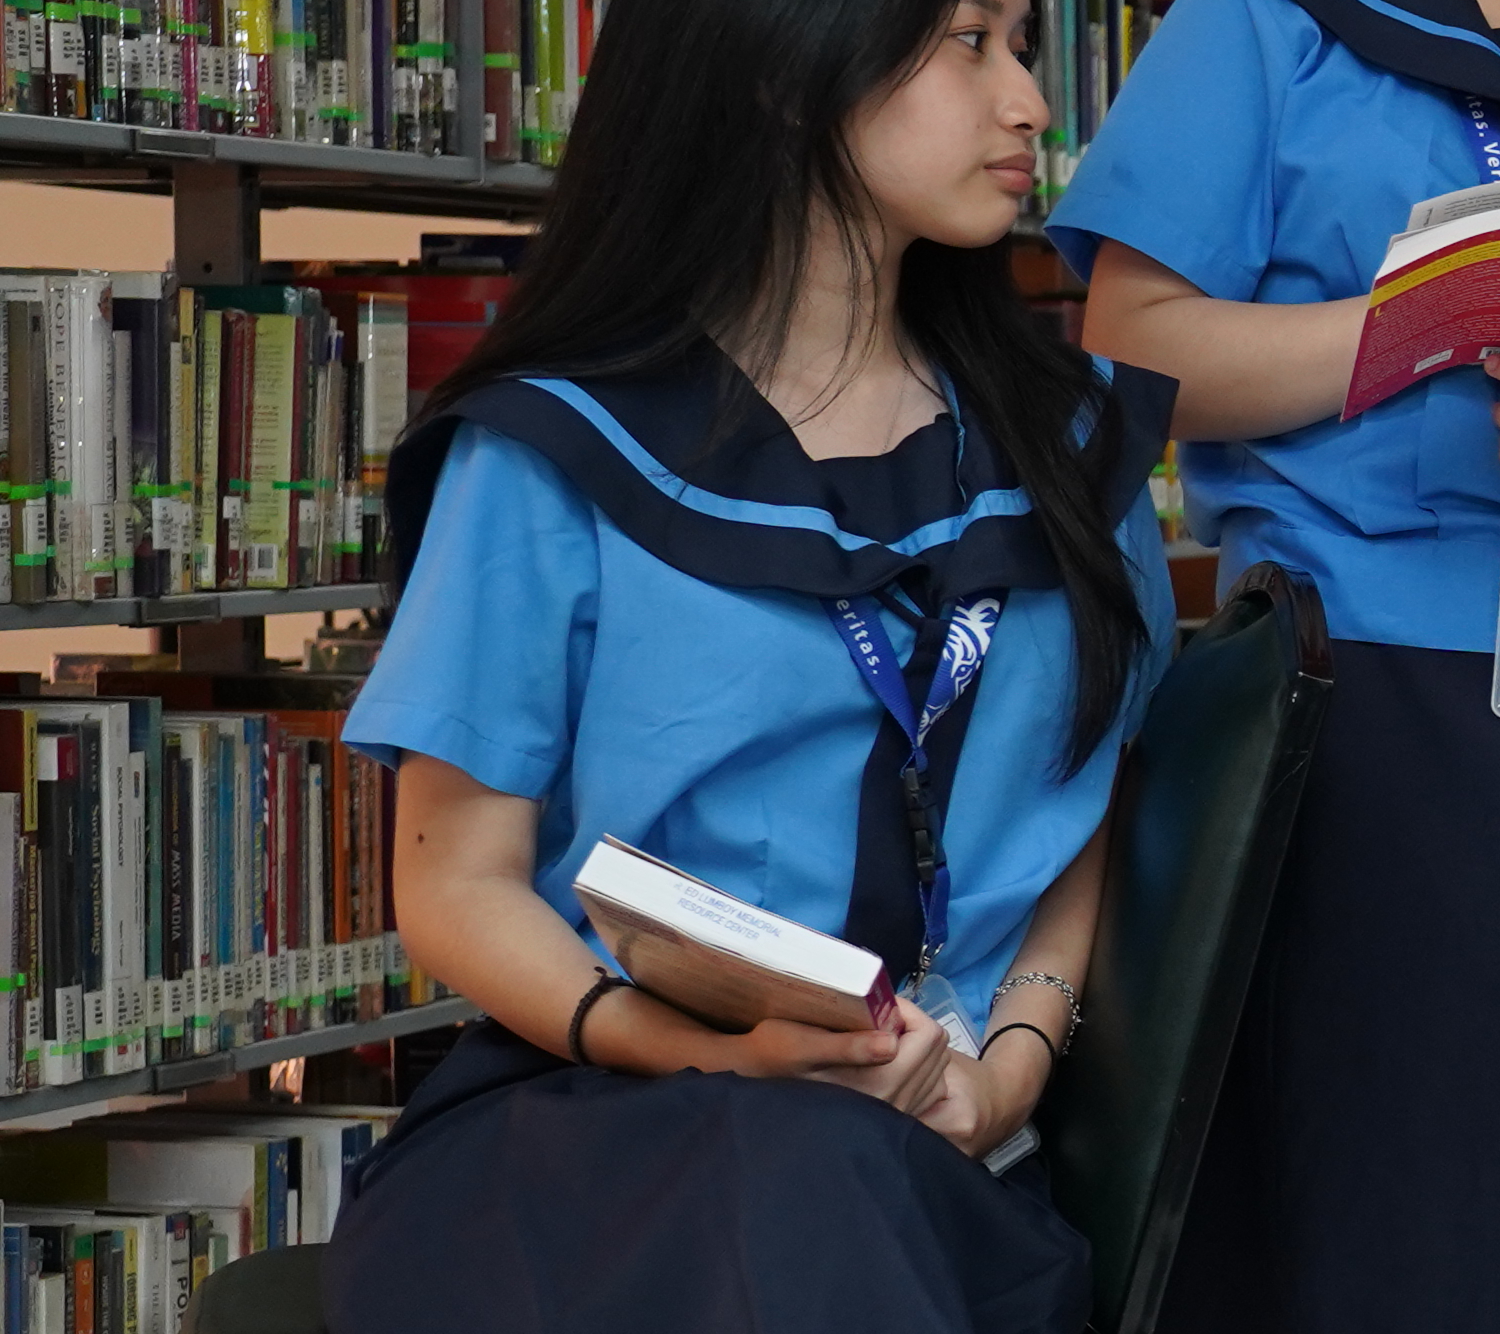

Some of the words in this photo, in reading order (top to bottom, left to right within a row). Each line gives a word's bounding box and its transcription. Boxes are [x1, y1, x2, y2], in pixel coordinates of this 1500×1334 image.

[54, 287, 67, 353] POPE
[834, 597, 881, 675] eritas.
[677, 896, 725, 928] RESOURCE
[722, 915, 761, 942] CENTER
[736, 906, 783, 939] MEMORIAL
